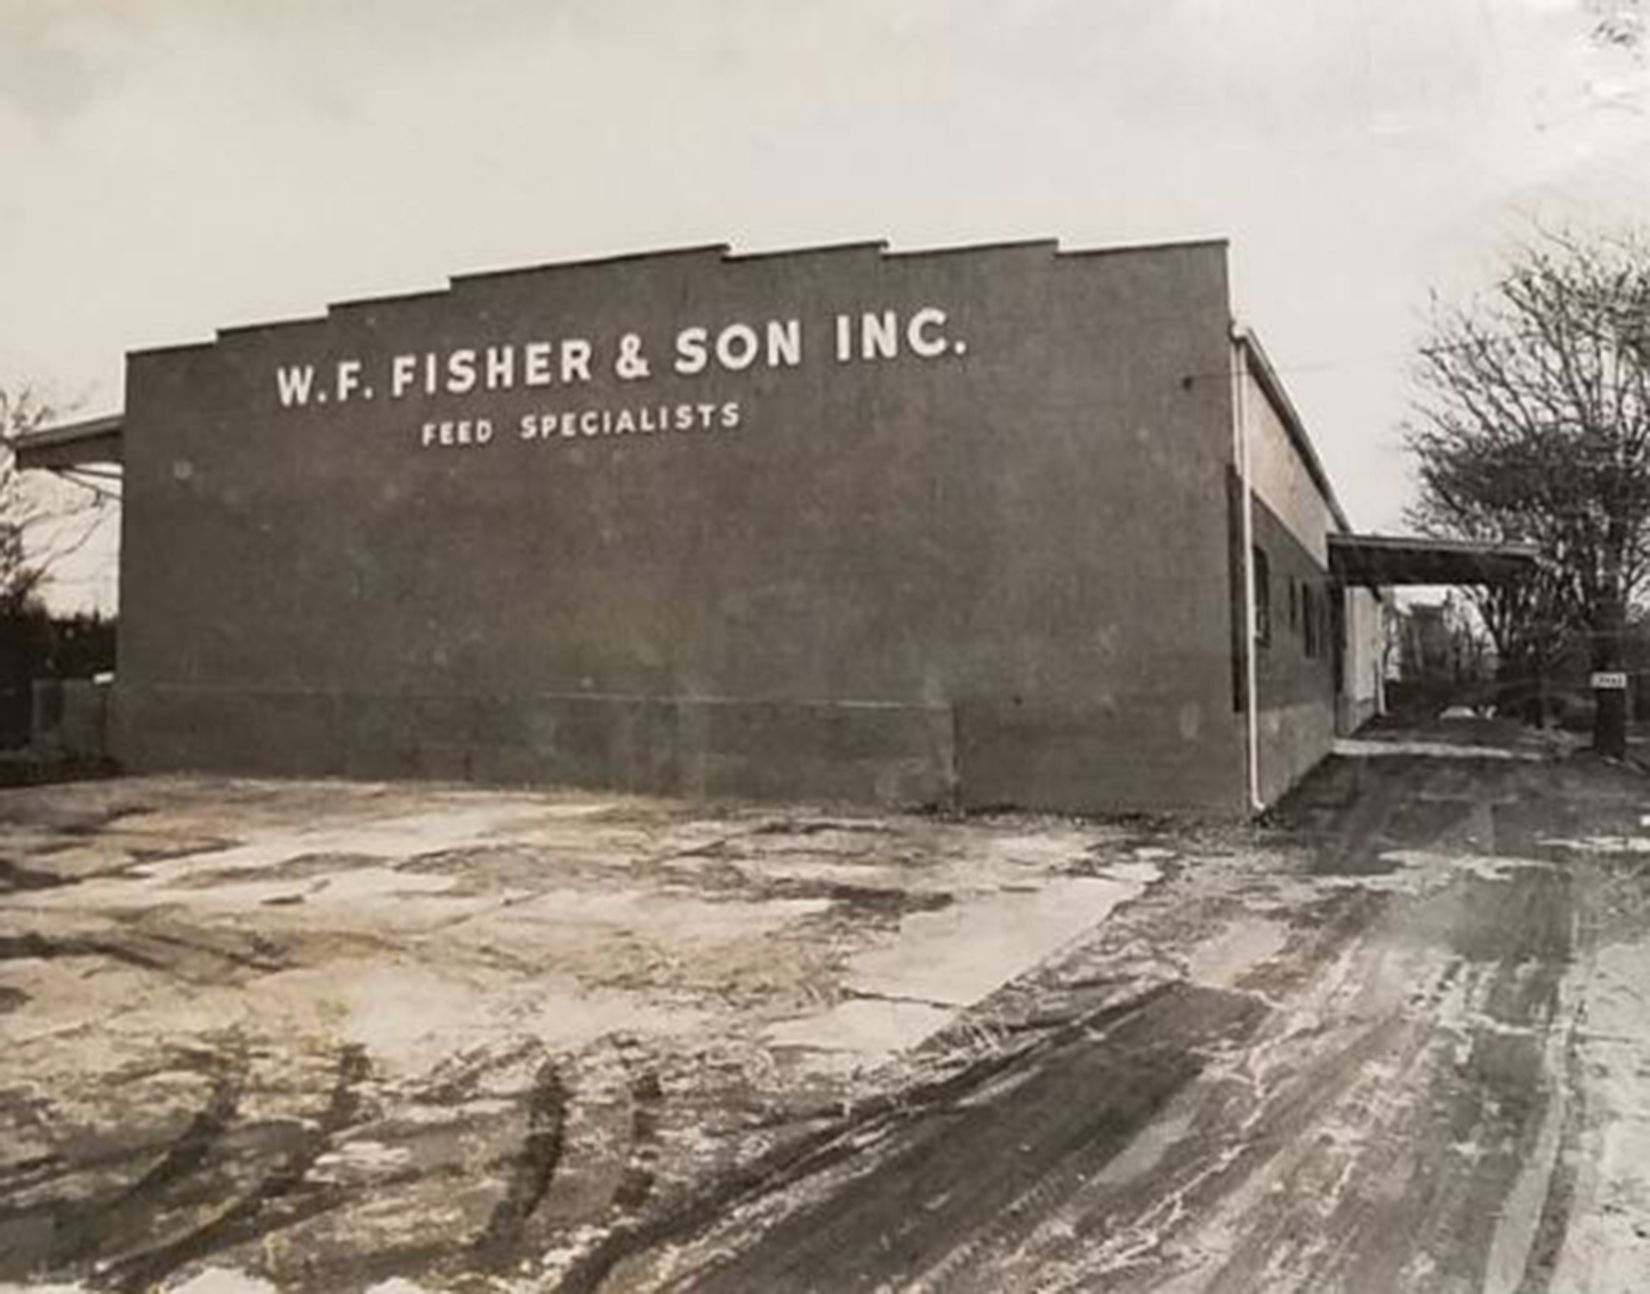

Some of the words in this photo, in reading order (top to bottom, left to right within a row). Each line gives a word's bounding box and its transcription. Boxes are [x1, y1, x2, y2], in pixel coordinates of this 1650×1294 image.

[392, 338, 592, 397] FISHER
[614, 332, 651, 380] &
[673, 319, 801, 374] SON
[836, 306, 967, 362] INC.
[421, 419, 493, 446] FEED
[520, 402, 740, 440] SPECIALISTS
